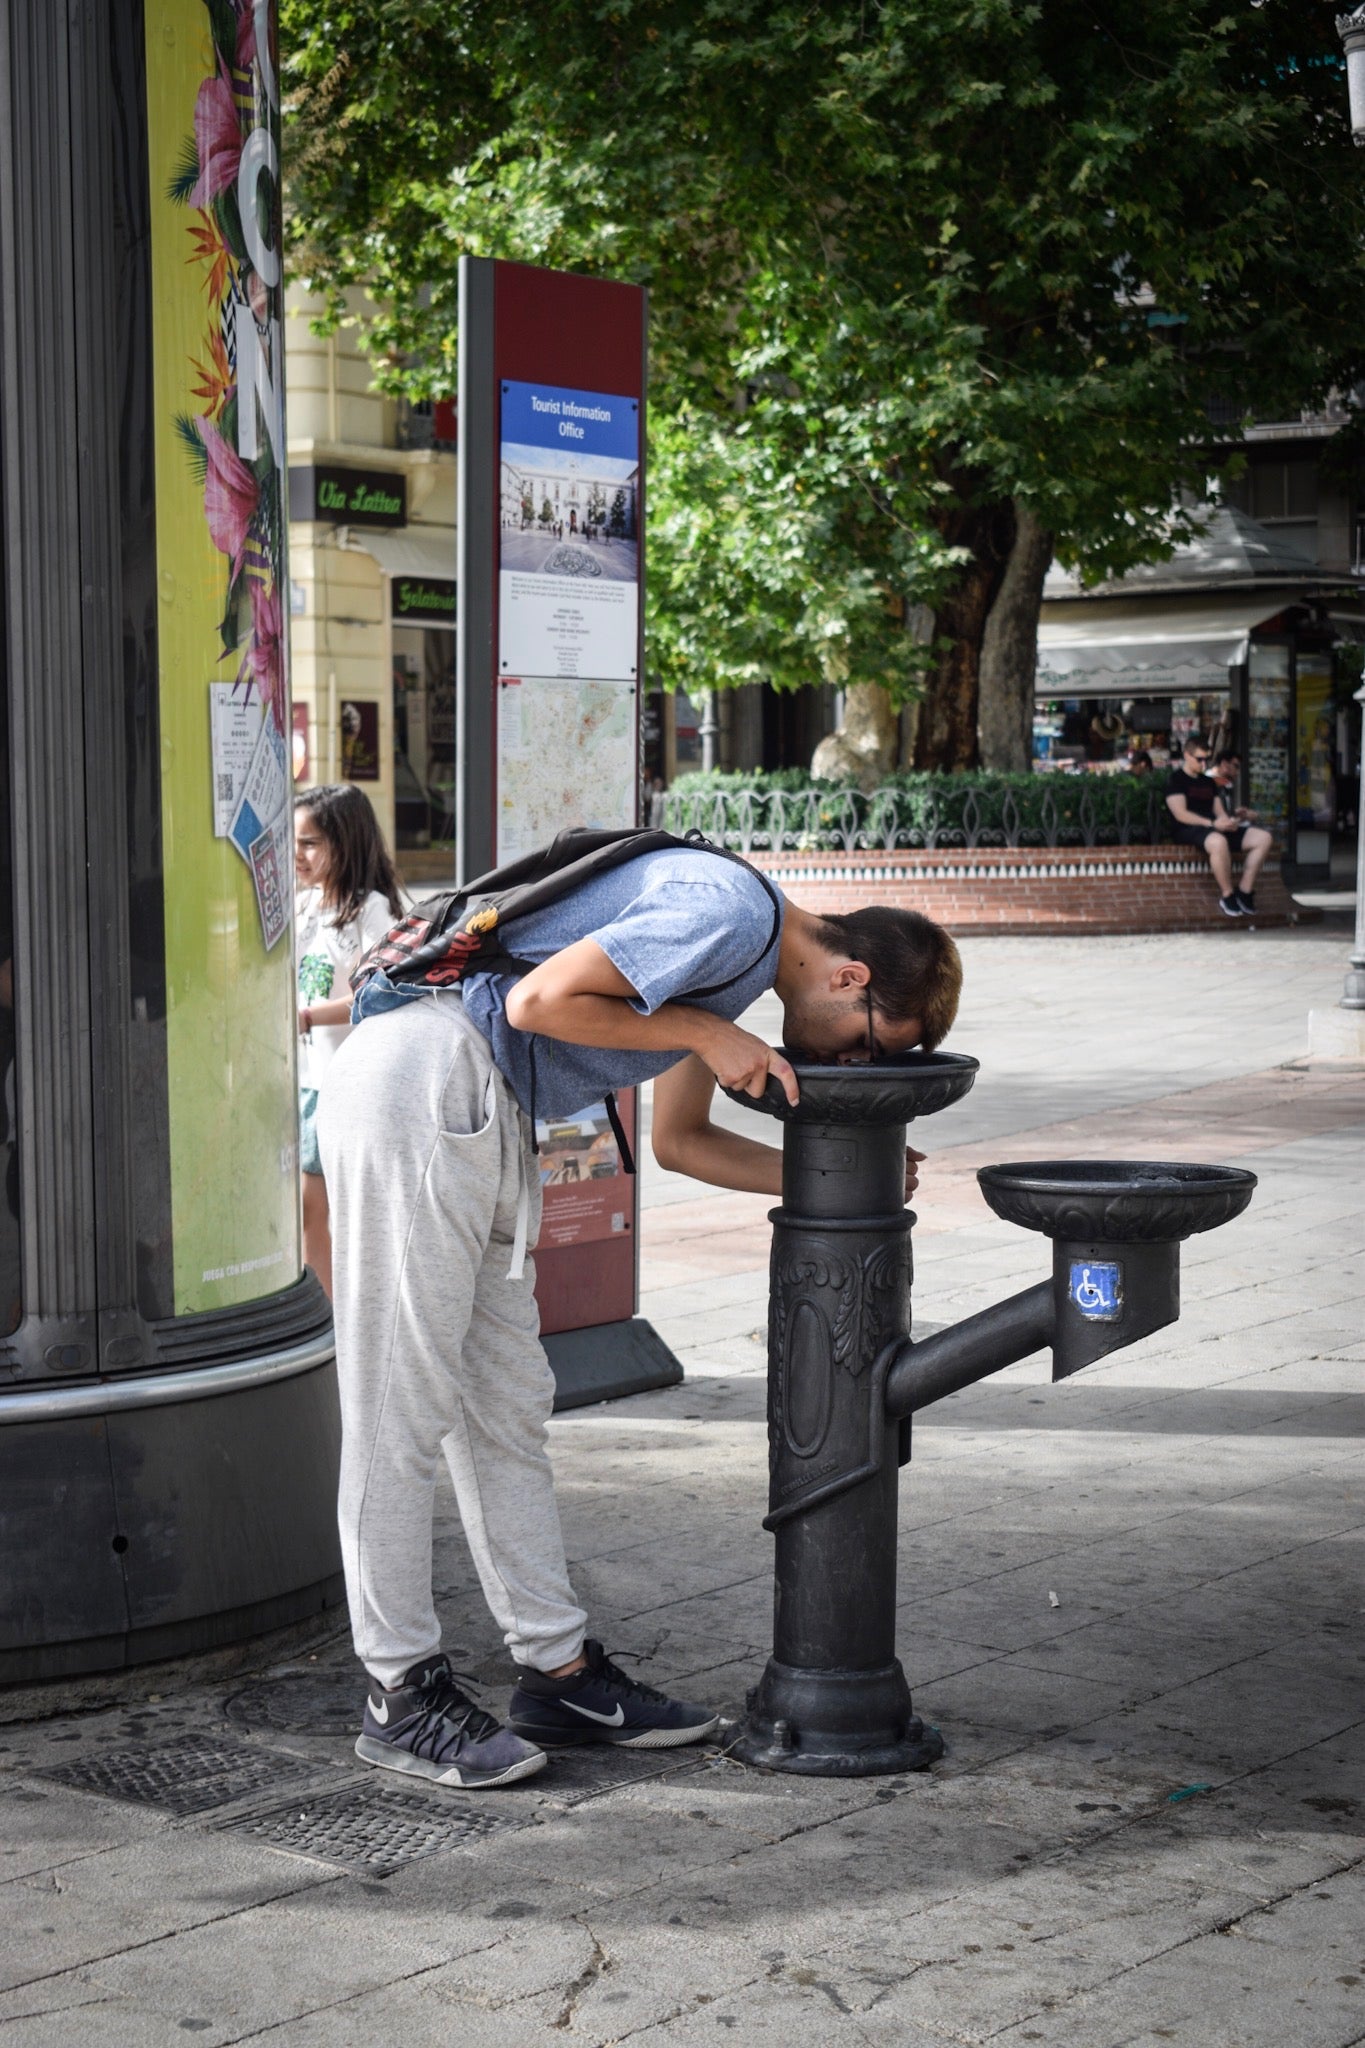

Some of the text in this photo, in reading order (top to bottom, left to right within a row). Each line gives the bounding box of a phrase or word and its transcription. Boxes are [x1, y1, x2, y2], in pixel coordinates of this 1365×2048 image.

[531, 396, 611, 422] Tourist Information
[558, 421, 585, 439] Office
[319, 480, 347, 508] Via
